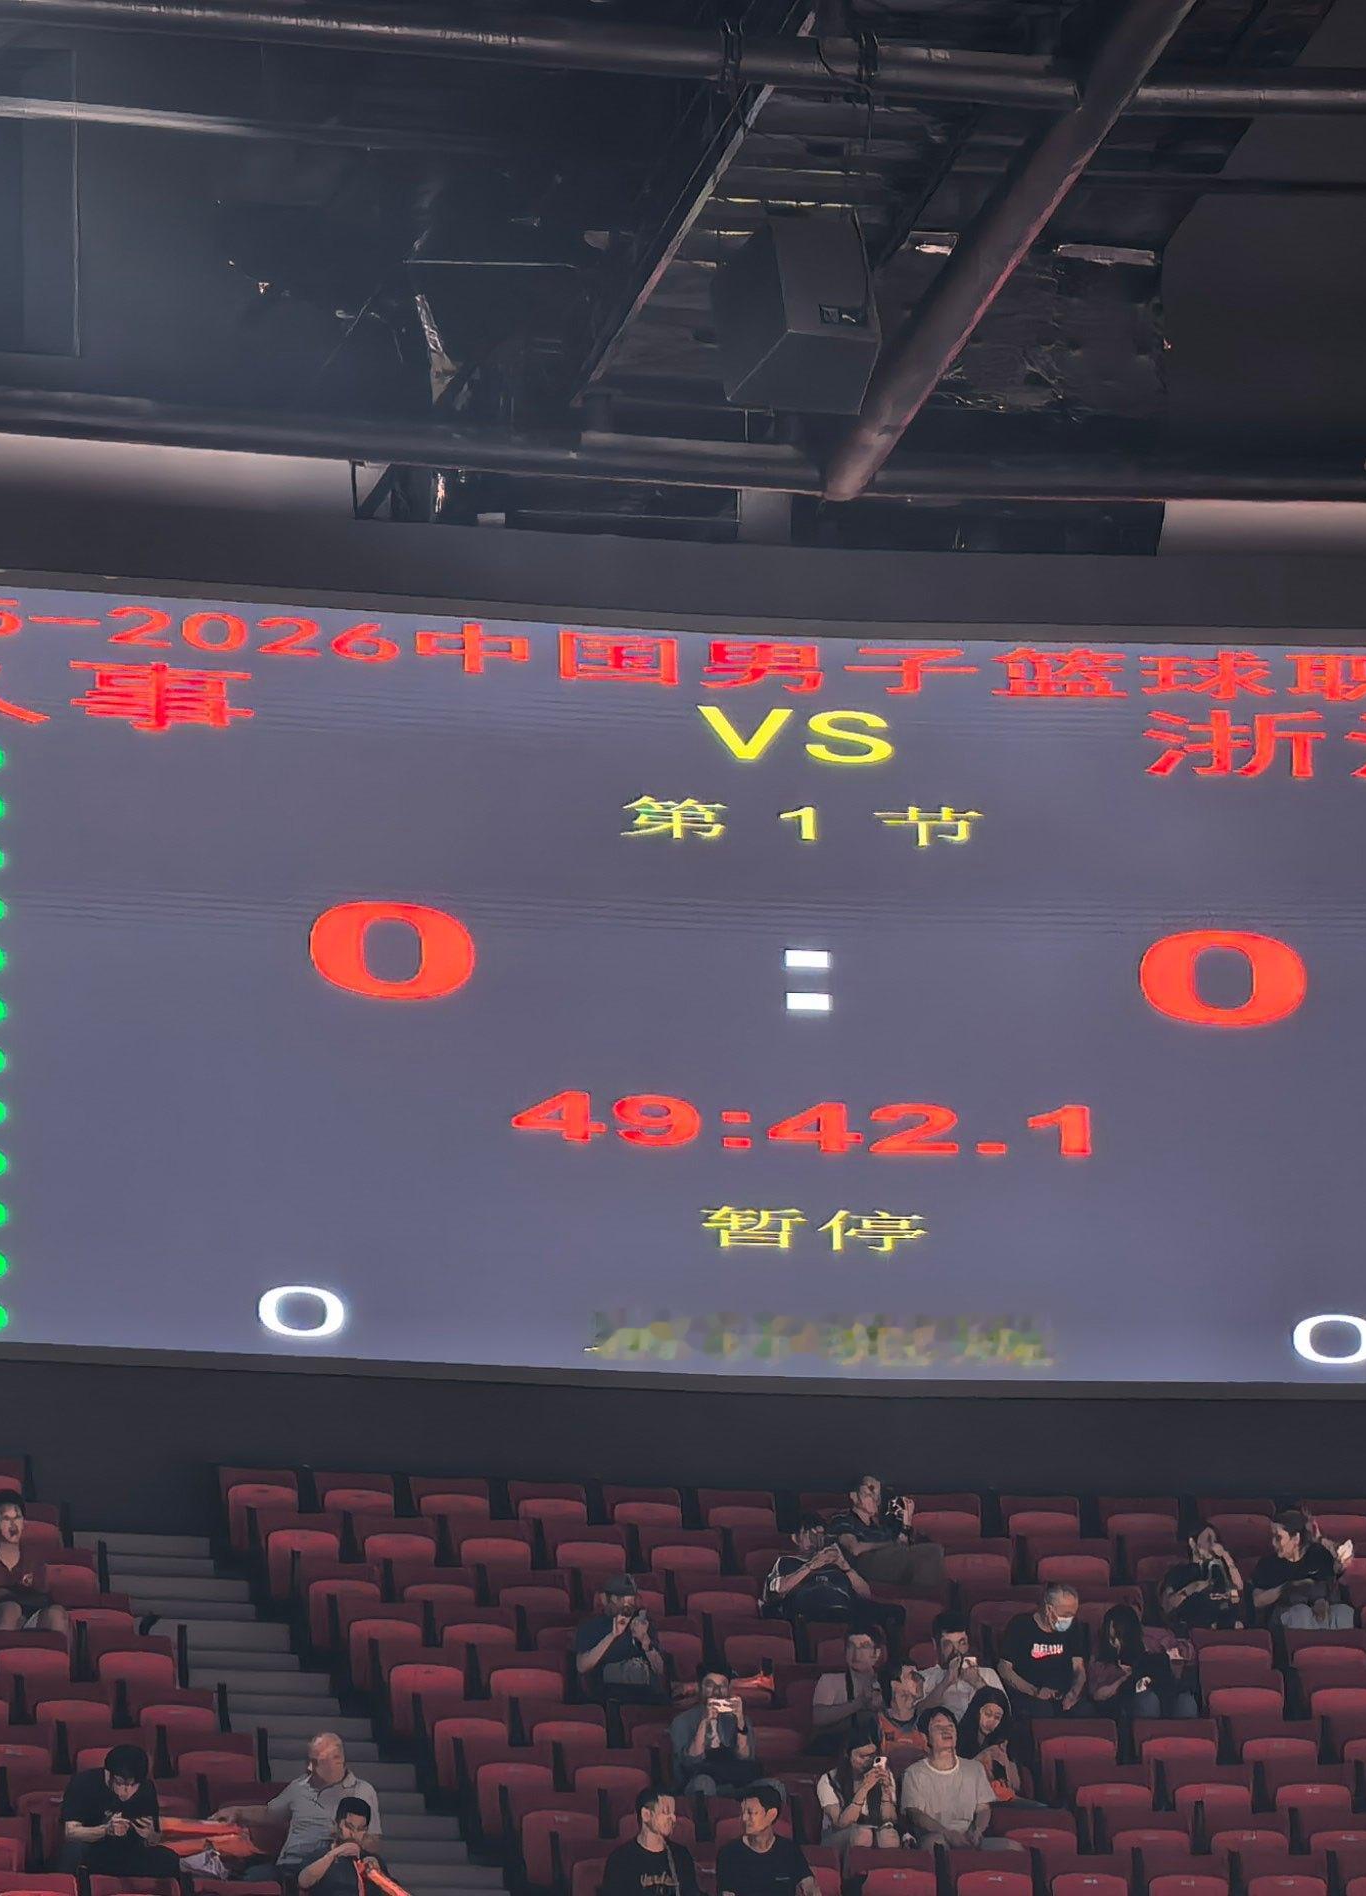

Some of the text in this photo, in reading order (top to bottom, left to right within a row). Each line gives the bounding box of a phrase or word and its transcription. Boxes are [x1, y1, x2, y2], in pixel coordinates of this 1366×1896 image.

[698, 703, 896, 769] VS
[309, 900, 477, 1003] 0
[1138, 928, 1308, 1029] 0
[511, 1090, 1095, 1158] 49:42.1
[701, 1203, 928, 1255] 暂停
[258, 1285, 346, 1338] 0
